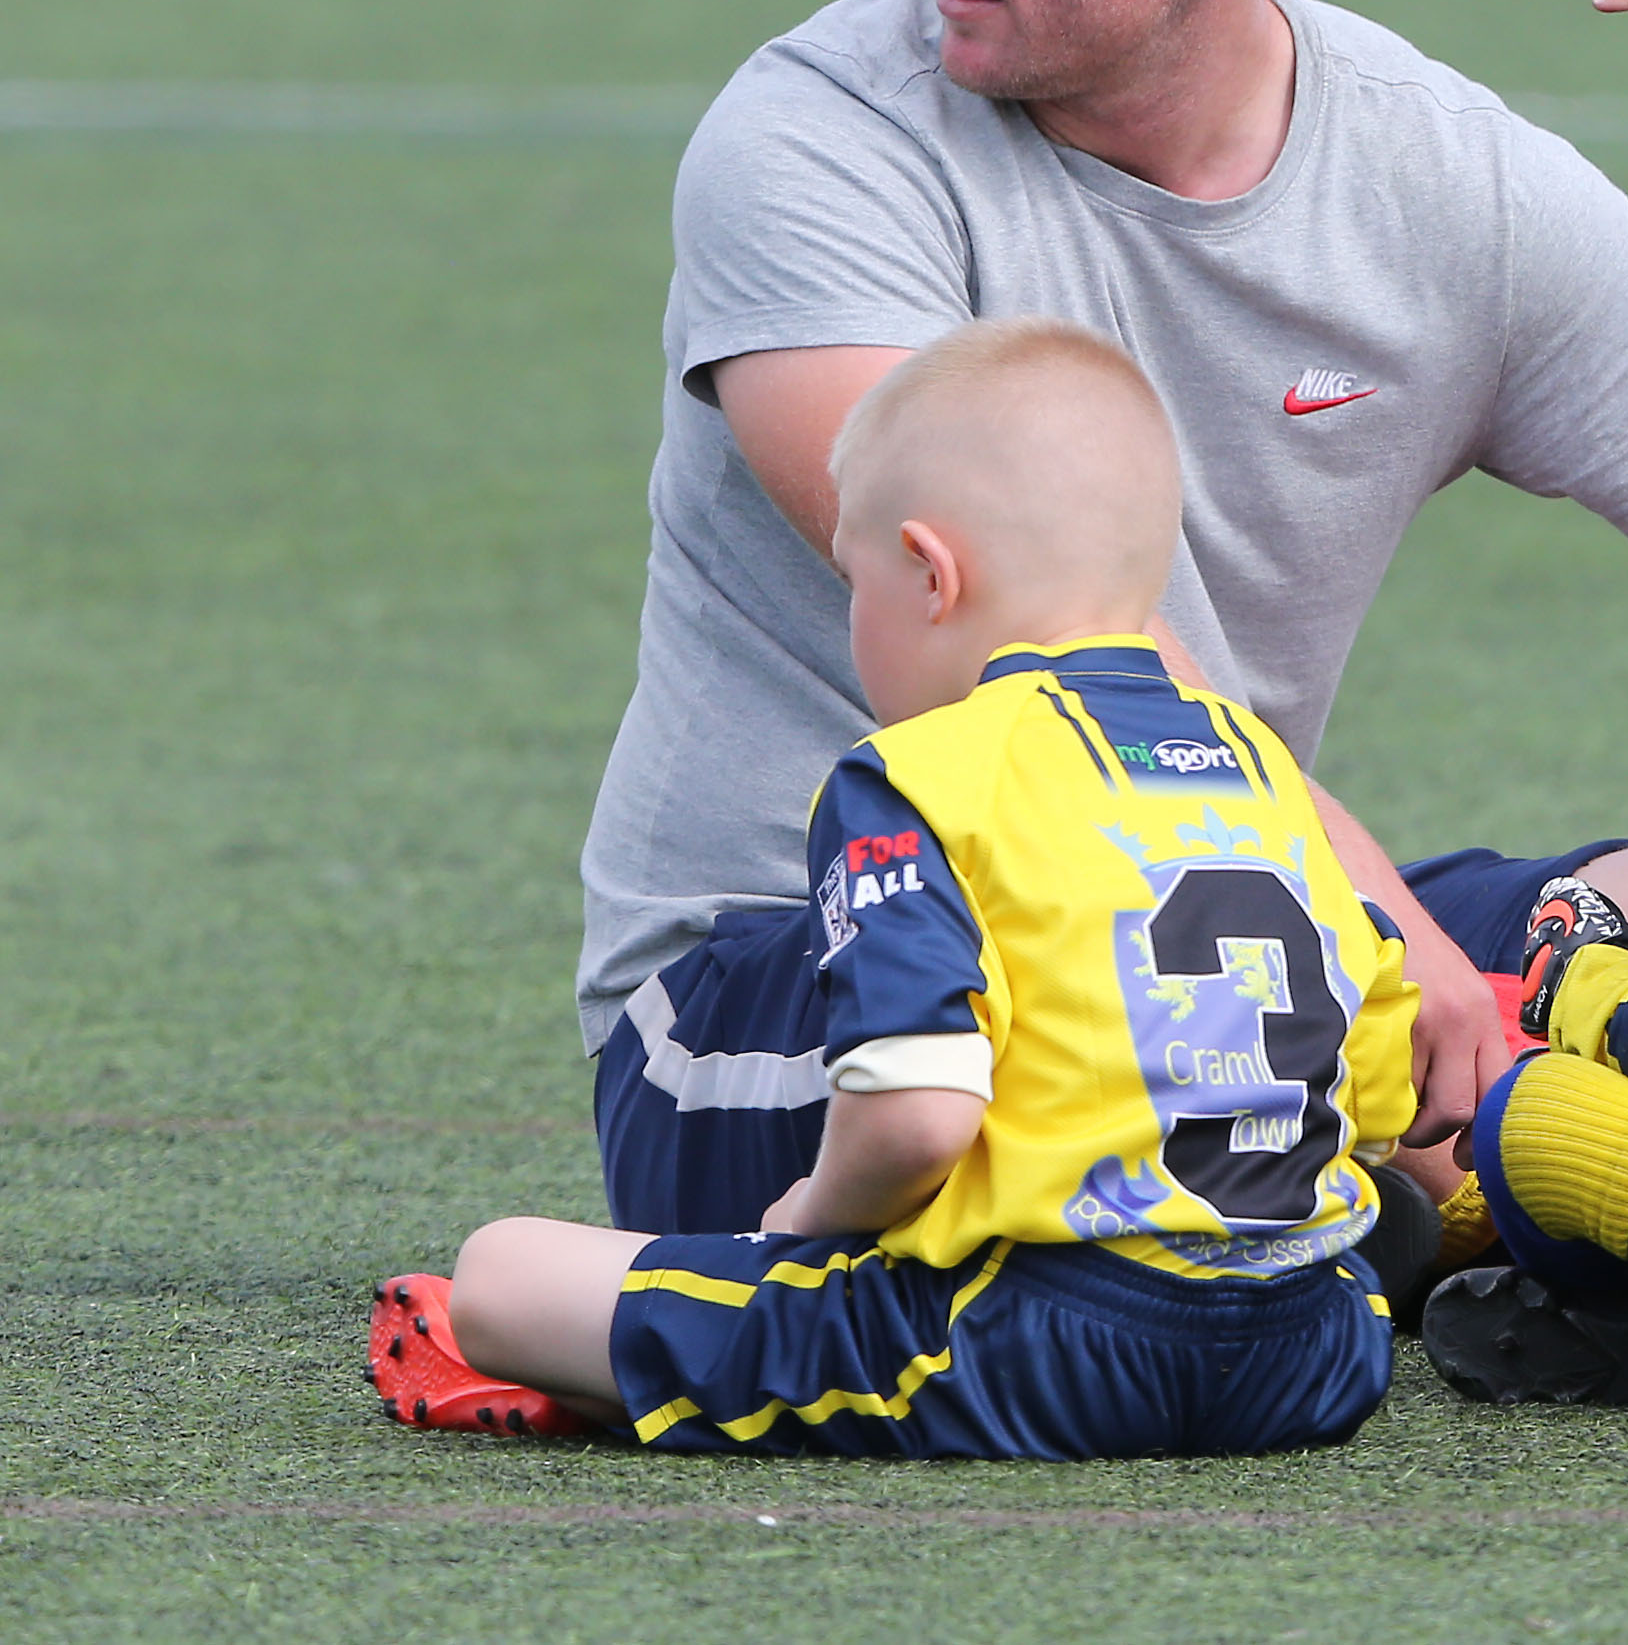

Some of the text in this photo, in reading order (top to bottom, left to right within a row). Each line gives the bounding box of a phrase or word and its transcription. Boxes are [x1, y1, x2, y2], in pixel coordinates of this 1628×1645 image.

[1296, 368, 1357, 398] NIKE
[847, 830, 921, 873] FOR
[853, 862, 926, 910] ALL
[1144, 866, 1350, 1222] 3
